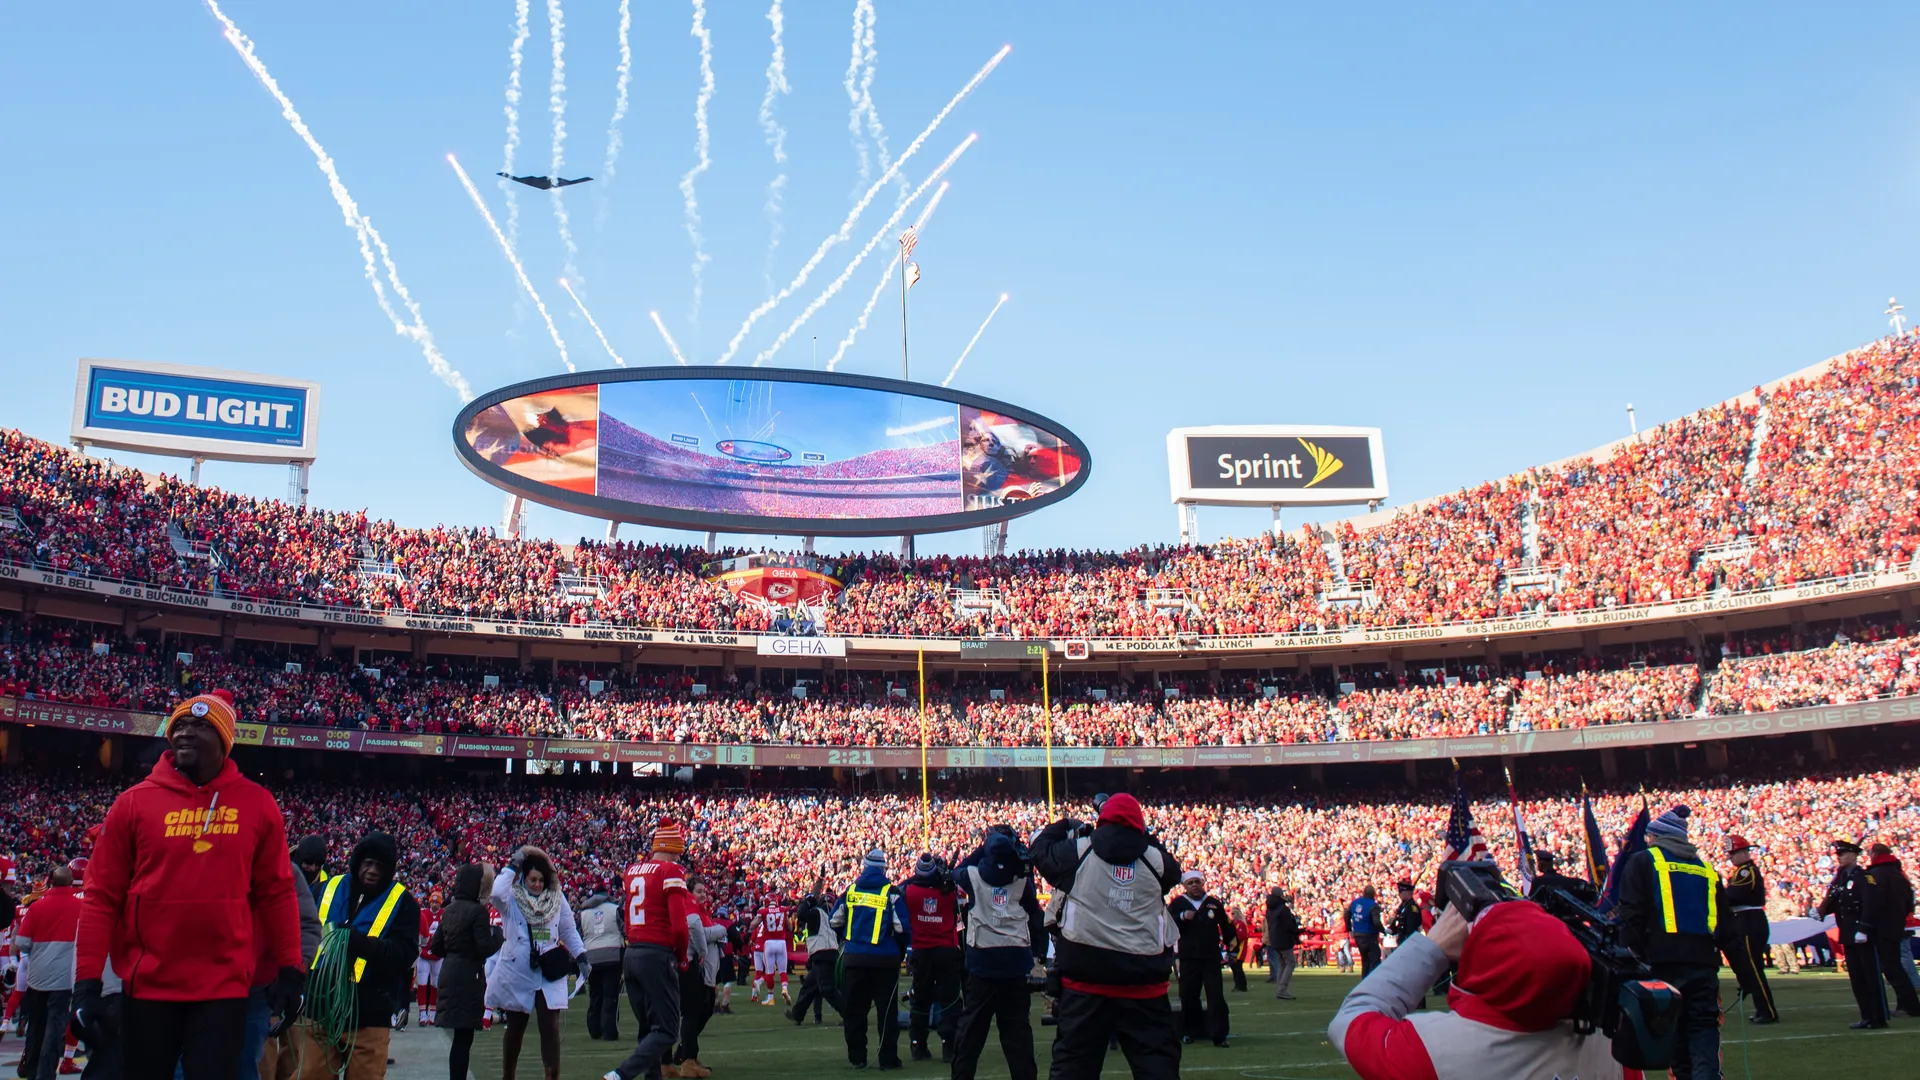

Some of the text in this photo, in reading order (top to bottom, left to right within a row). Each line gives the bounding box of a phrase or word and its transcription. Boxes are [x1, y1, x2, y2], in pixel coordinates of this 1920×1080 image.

[101, 386, 293, 428] BUD LIGHT
[1218, 453, 1303, 485] Sprint
[772, 570, 798, 578] GEHA
[1905, 573, 1917, 581] 73
[42, 574, 95, 590] 78 B. BELL
[1813, 587, 1824, 596] D.
[1828, 578, 1877, 594] CHERRY
[119, 587, 208, 607] 86 B. BUCHANAN
[1690, 604, 1700, 612] C.
[1704, 593, 1772, 610] McCLINTON
[230, 602, 300, 618] 89 O. TAYLOR
[1592, 615, 1600, 623] J.
[1603, 609, 1650, 622] RUDNAY
[323, 612, 384, 626] 71 E. BUDDE
[405, 619, 418, 628] 63
[433, 621, 474, 632] LANIER
[506, 625, 515, 634] E.
[519, 626, 564, 637] THOMAS
[1481, 624, 1491, 633] S.
[1493, 619, 1551, 632] HEADRICK
[616, 631, 653, 642] STRAM
[673, 635, 738, 645] 44 J. WILSON
[1288, 638, 1298, 646] A.
[1300, 636, 1342, 646] HAYNES
[1373, 633, 1382, 641] J.
[1384, 629, 1443, 640] STENERUD
[772, 639, 828, 655] GEHA
[1027, 646, 1043, 655] 2:21
[1067, 643, 1085, 656] 25
[1127, 641, 1175, 650] PODOLAK
[1209, 641, 1218, 649] J.
[1219, 640, 1253, 649] LYNCH
[21, 704, 73, 715] AVAILABLE
[4, 708, 125, 729] CHIEFS.COM
[1696, 718, 1771, 736] 2020
[1780, 706, 1882, 728] CHIEFS
[273, 727, 288, 736] KC
[326, 730, 350, 739] 0:00
[1572, 729, 1655, 744] ARROWHEAD
[273, 736, 295, 746] TEN
[326, 740, 350, 749] 0:00
[366, 739, 398, 747] PASSING
[459, 743, 490, 751] RUSHING
[621, 749, 663, 757] TURNOVERS
[828, 750, 874, 765] 2:21
[164, 805, 239, 825] chiefs
[1116, 866, 1133, 880] NFL
[1109, 887, 1134, 900] MEDIA
[629, 876, 646, 925] 2
[766, 912, 785, 932] 87
